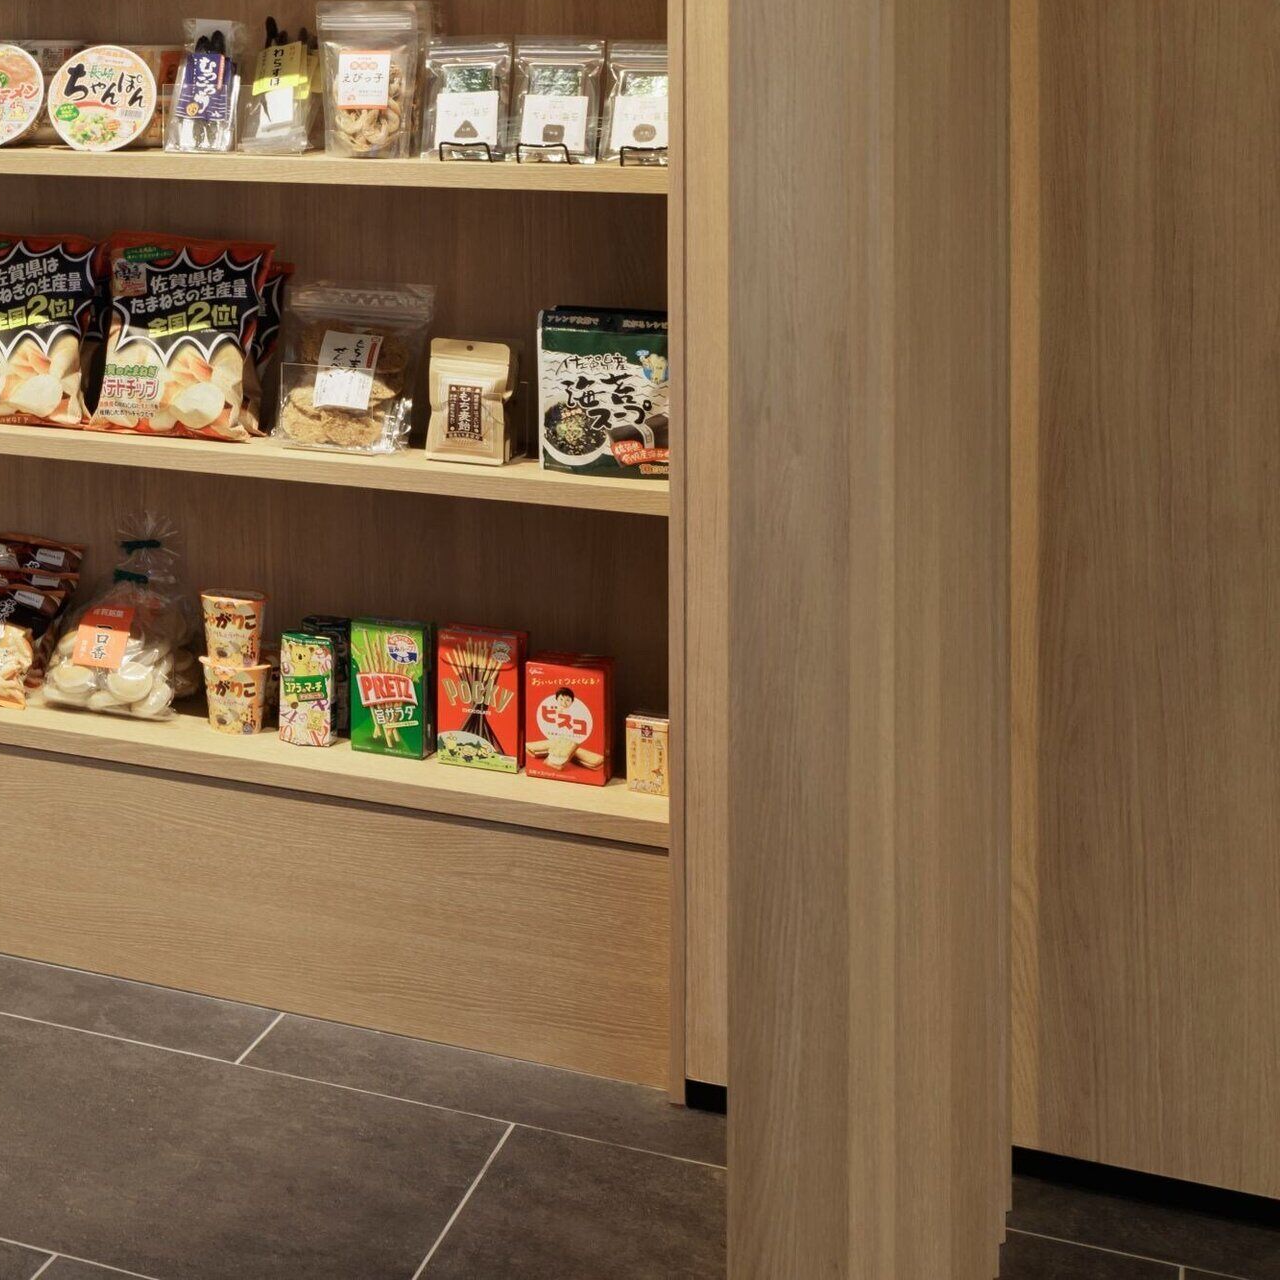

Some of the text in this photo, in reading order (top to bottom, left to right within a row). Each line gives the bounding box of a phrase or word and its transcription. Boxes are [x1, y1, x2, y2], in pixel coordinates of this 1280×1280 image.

[63, 63, 146, 108] ちゃんぽん
[130, 278, 248, 314] たまねぎの生産量
[149, 267, 225, 295] 佐賀県は
[359, 675, 414, 701] PRETZ
[541, 705, 588, 736] ビスコ
